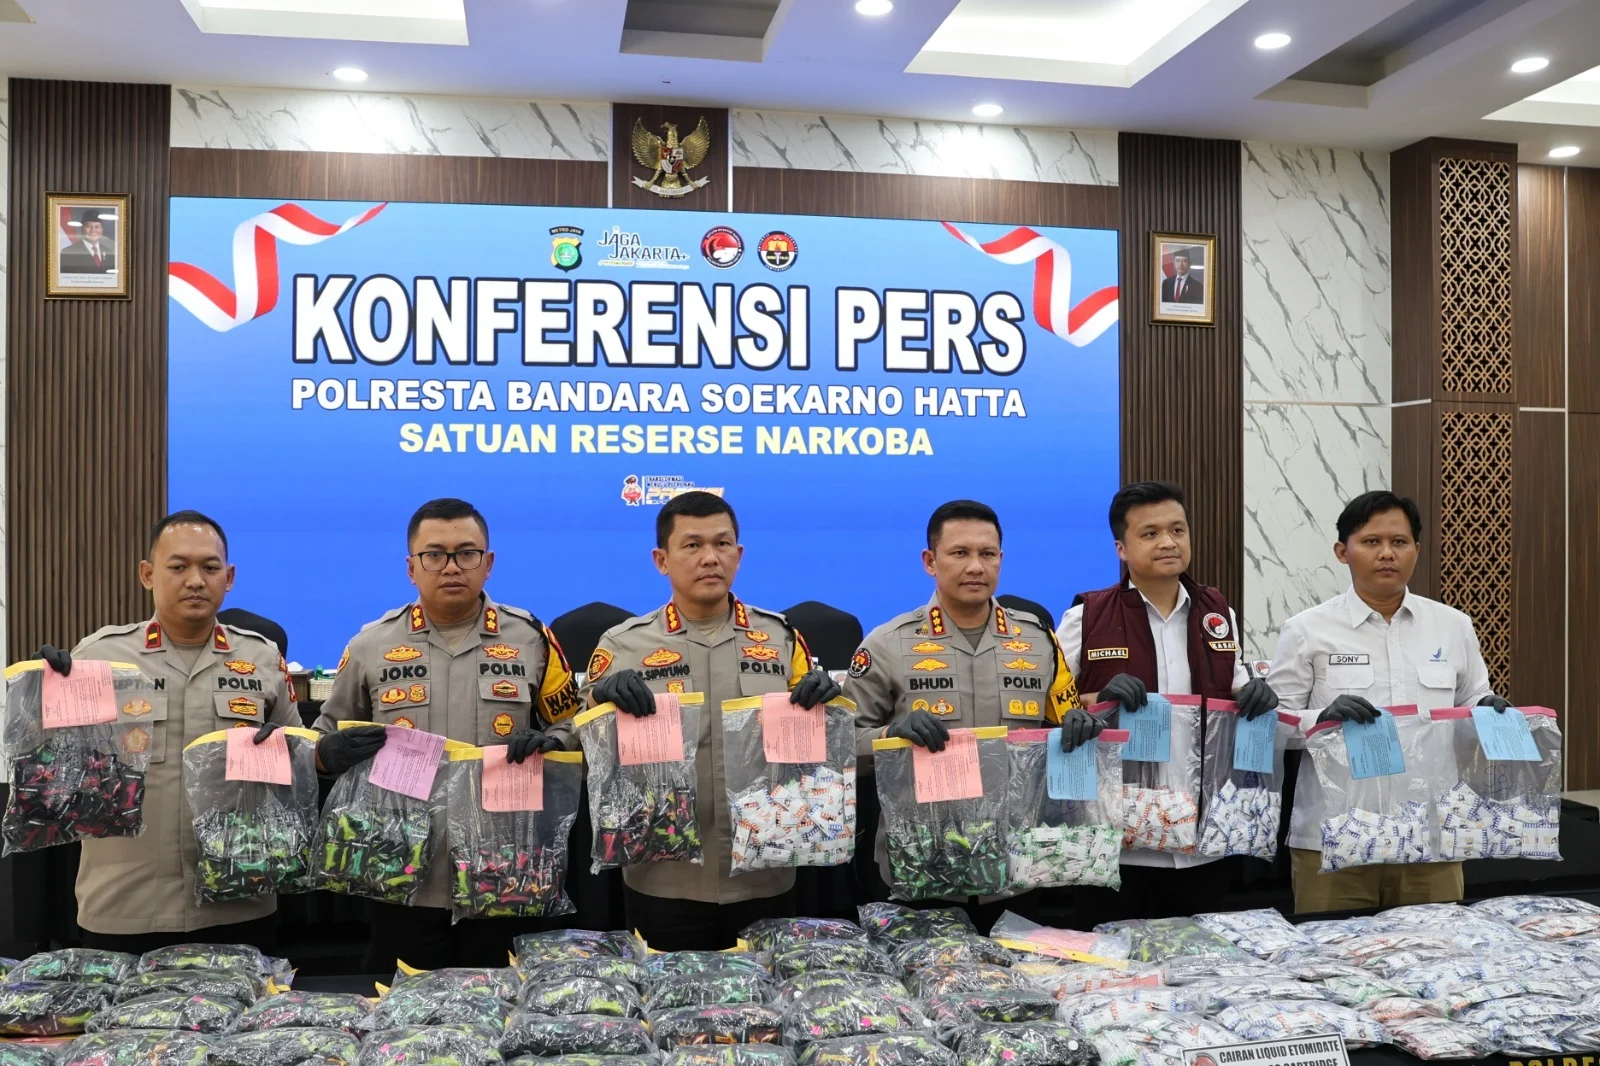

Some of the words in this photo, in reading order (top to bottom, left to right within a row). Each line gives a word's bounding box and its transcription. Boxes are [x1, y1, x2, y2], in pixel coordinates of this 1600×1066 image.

[598, 231, 641, 246] JAGA
[609, 245, 680, 260] JAKARTA
[293, 273, 809, 371] KONFERENSI
[835, 286, 1026, 376] PERS
[292, 378, 497, 411] POLRESTA
[507, 380, 690, 413] BANDARA
[700, 382, 903, 416] SOEKARNO
[914, 386, 1027, 418] HATTA
[399, 422, 557, 454] SATUAN
[570, 424, 744, 455] RESERSE
[756, 425, 934, 456] NARKOBA
[1091, 649, 1126, 658] MICHAEL
[1336, 655, 1360, 663] SONY
[380, 664, 428, 682] JOKO
[479, 662, 526, 677] POLRI
[740, 661, 785, 676] POLRI
[217, 676, 263, 691] POLRI
[909, 677, 954, 690] BHUDI
[1003, 676, 1042, 690] POLRI
[1219, 1048, 1256, 1064] CAIRAN
[1256, 1045, 1288, 1060] LIQUID
[1288, 1040, 1340, 1056] ETOMIDATE
